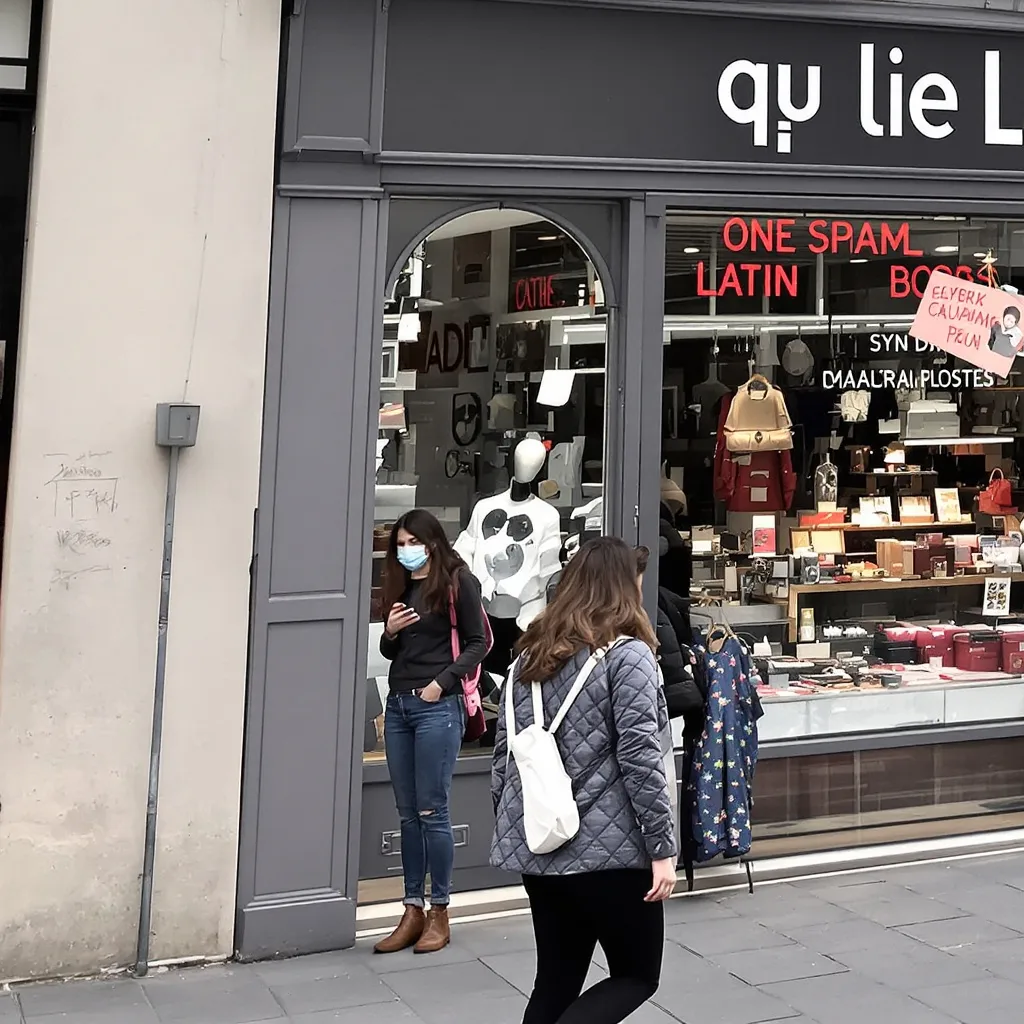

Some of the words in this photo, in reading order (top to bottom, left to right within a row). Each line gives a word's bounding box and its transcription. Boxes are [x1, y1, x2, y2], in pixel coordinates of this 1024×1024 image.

[860, 43, 959, 139] lie
[723, 217, 797, 253] ONE
[696, 261, 798, 297] LATIN
[869, 333, 909, 353] SYN
